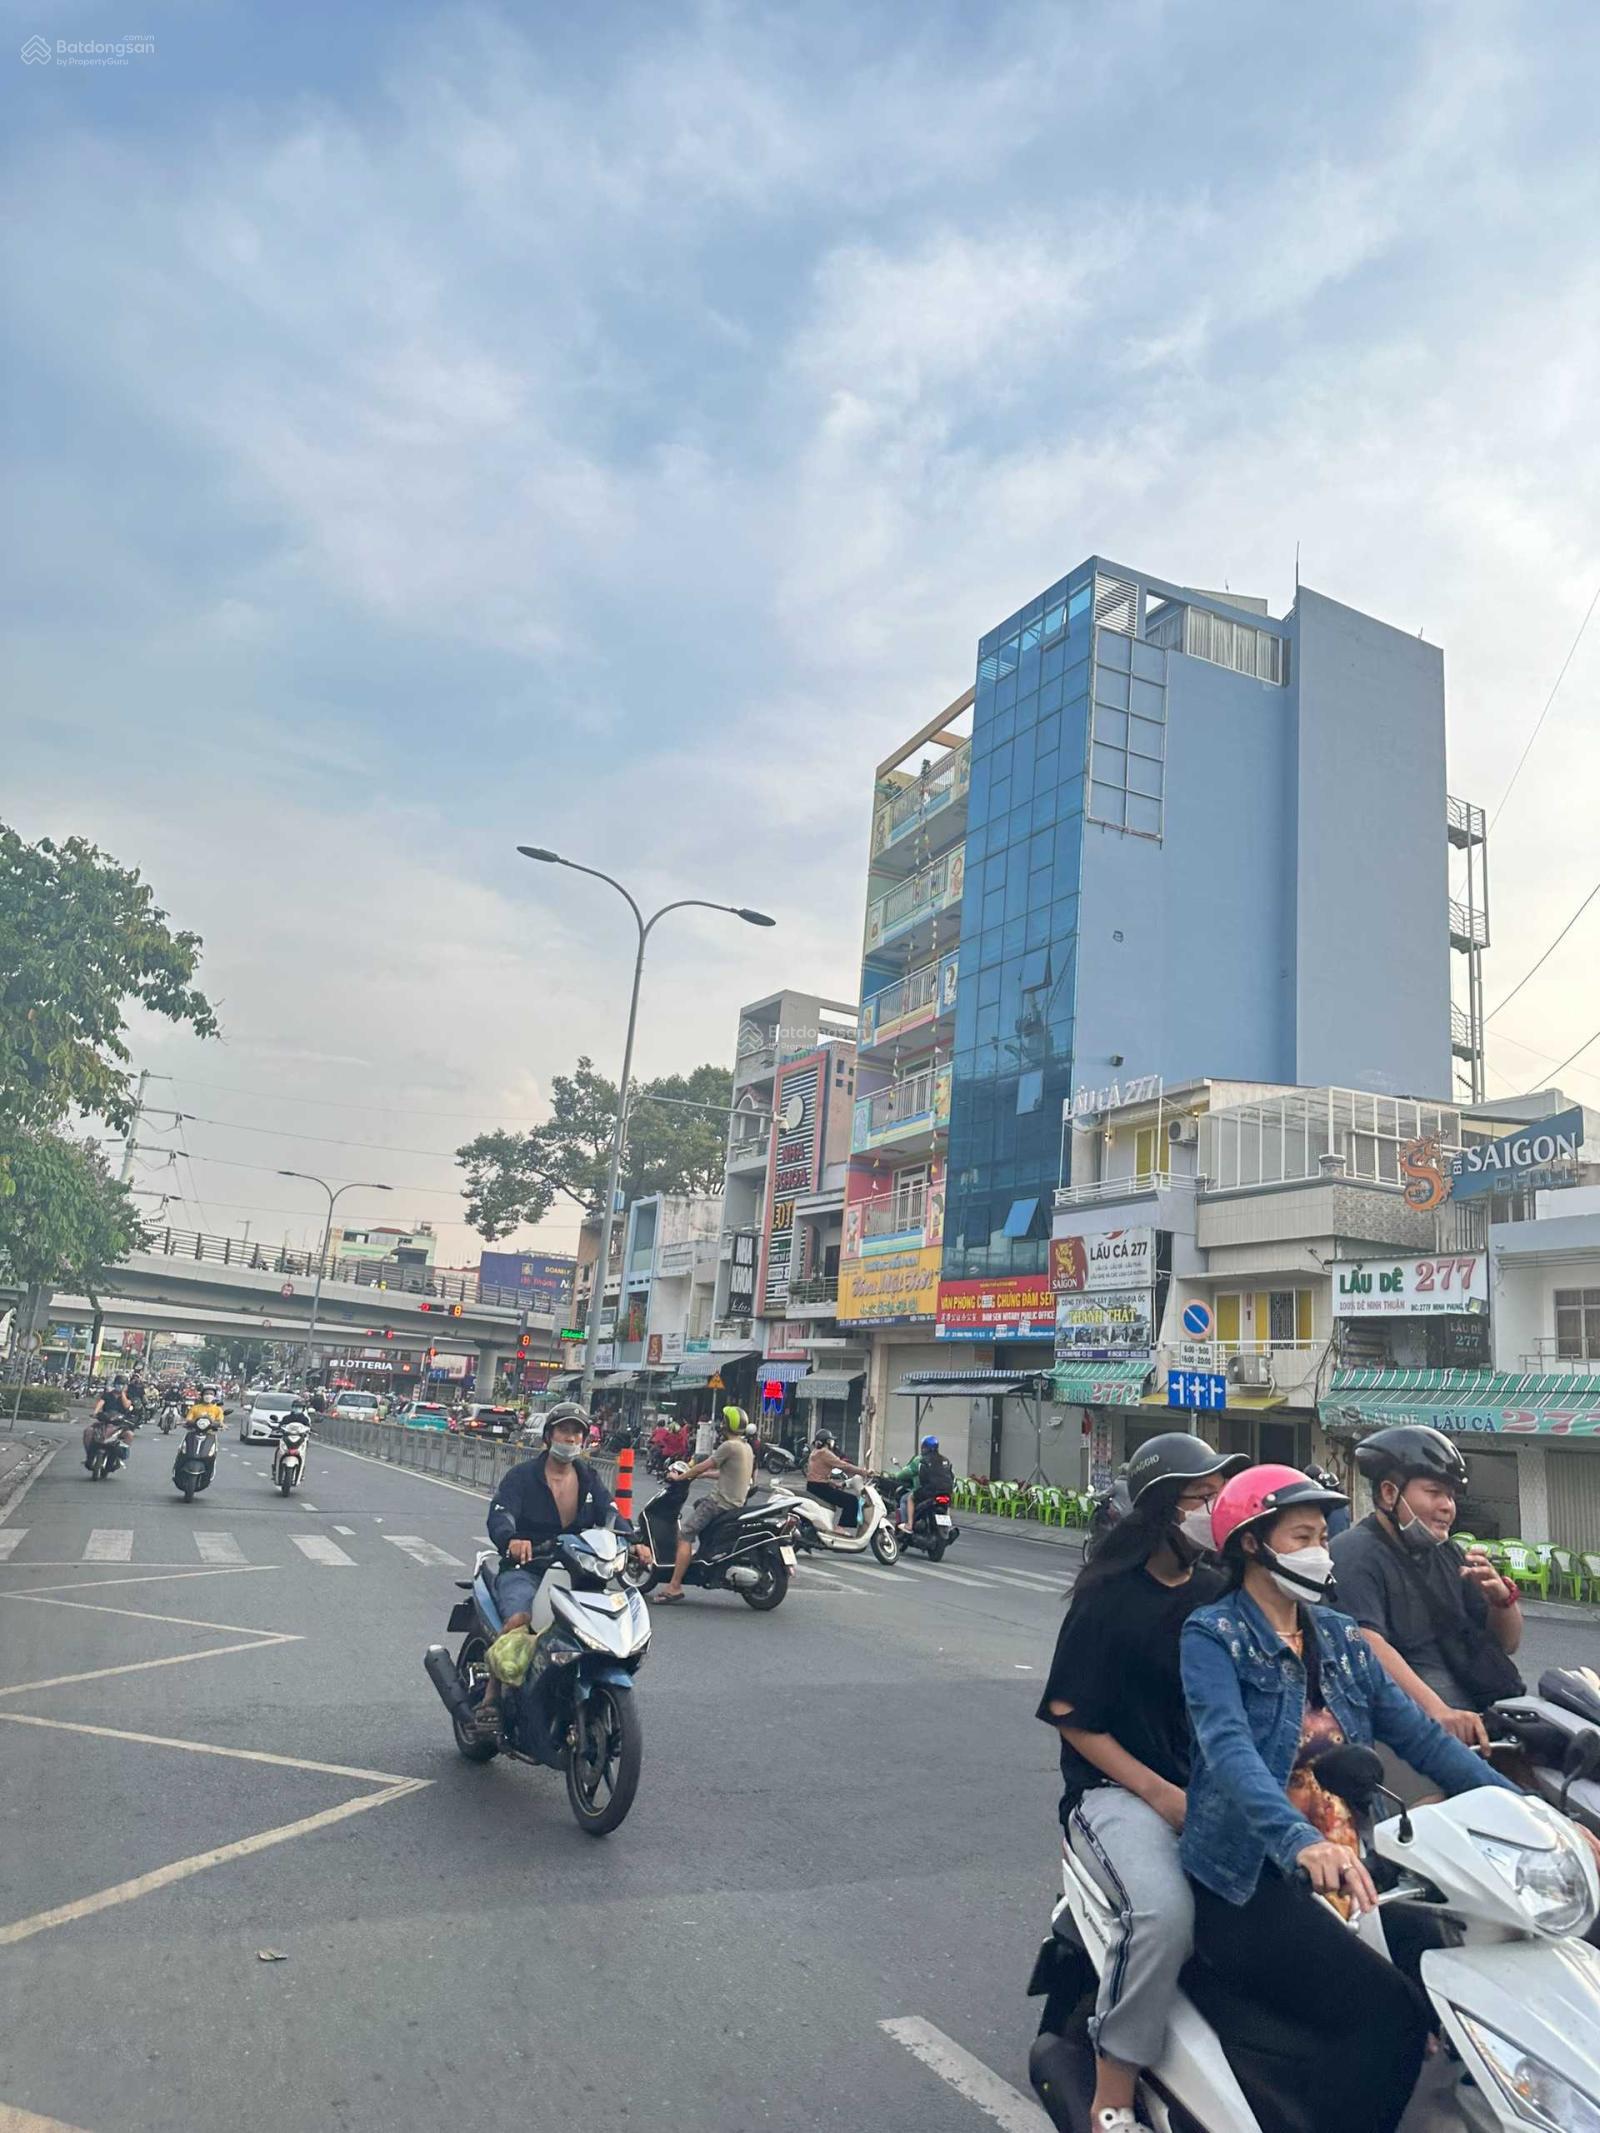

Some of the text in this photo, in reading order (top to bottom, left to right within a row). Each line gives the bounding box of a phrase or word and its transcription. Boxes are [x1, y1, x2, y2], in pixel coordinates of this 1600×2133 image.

[1466, 1132, 1577, 1172] SAIGON
[735, 1236, 753, 1264] NHA
[1113, 1239, 1128, 1258] CÁ
[1131, 1242, 1148, 1257] 277
[730, 1266, 753, 1294] KHOA
[1052, 1279, 1077, 1289] SAIGON
[1379, 1266, 1404, 1293] DÊ
[1415, 1257, 1477, 1293] 277
[1455, 1334, 1479, 1347] 277
[340, 1359, 393, 1371] LOTTERIA
